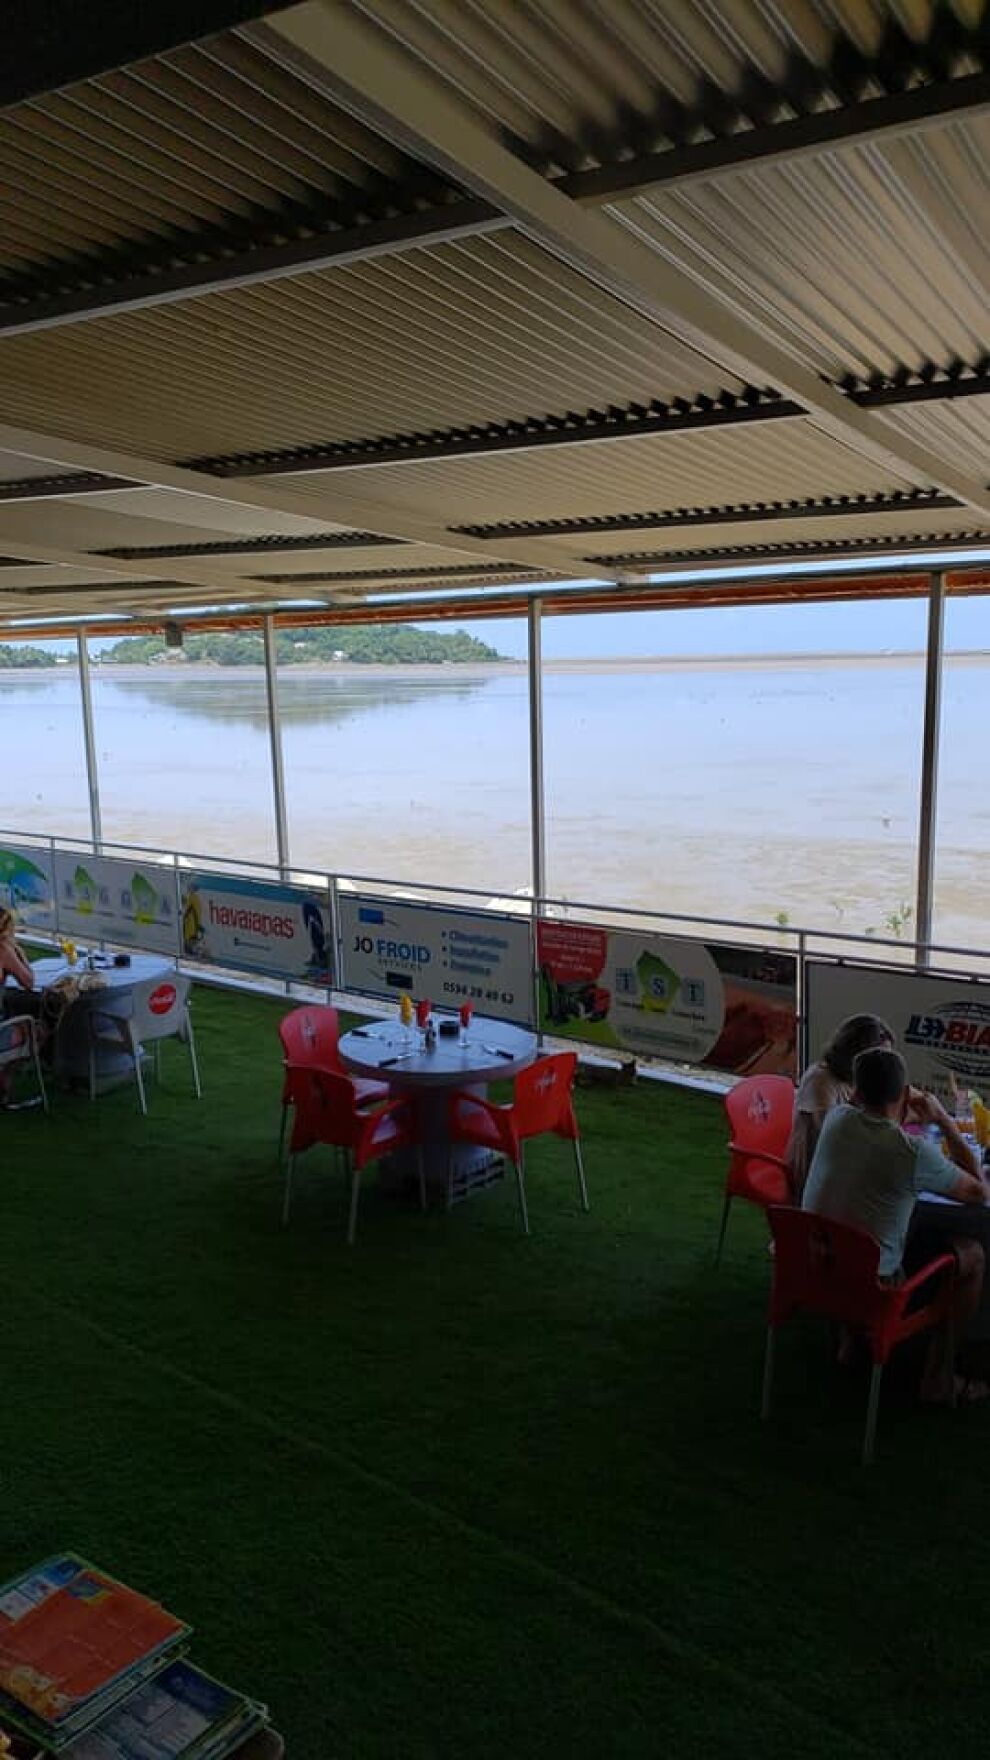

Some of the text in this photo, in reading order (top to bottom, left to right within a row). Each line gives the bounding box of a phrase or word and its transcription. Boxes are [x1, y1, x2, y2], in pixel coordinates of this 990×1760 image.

[209, 900, 293, 939] havaianas
[353, 936, 431, 963] JO FROID
